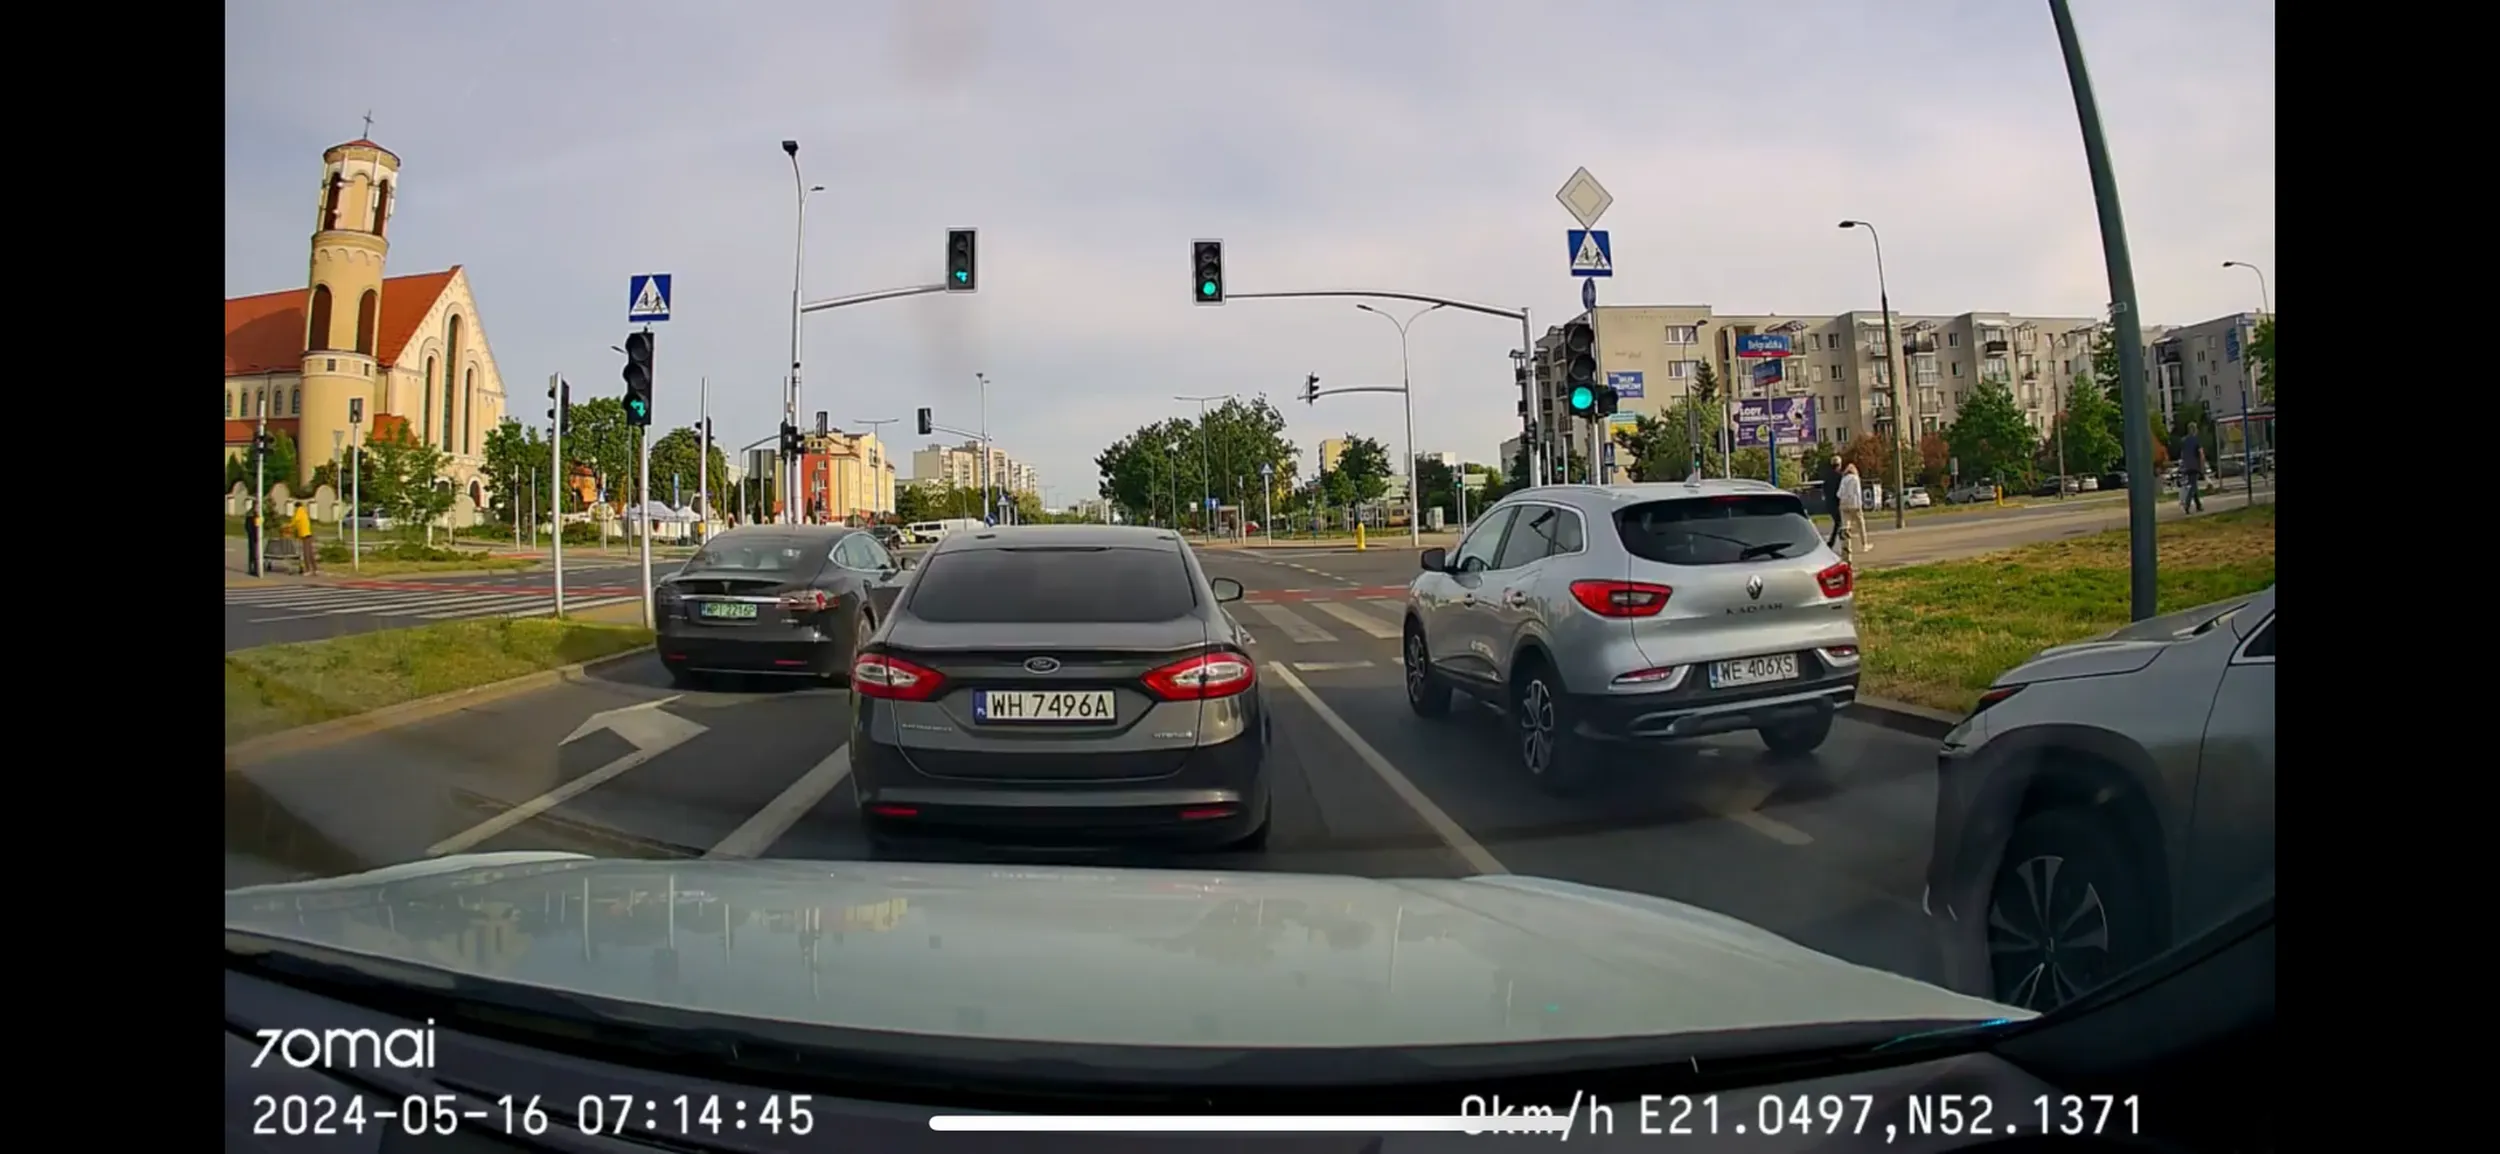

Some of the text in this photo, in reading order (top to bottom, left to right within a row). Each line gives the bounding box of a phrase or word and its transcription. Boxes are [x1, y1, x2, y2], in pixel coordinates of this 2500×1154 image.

[1740, 408, 1761, 416] LODY
[1721, 655, 1794, 680] WE 406XS
[992, 694, 1109, 717] WH 7496A
